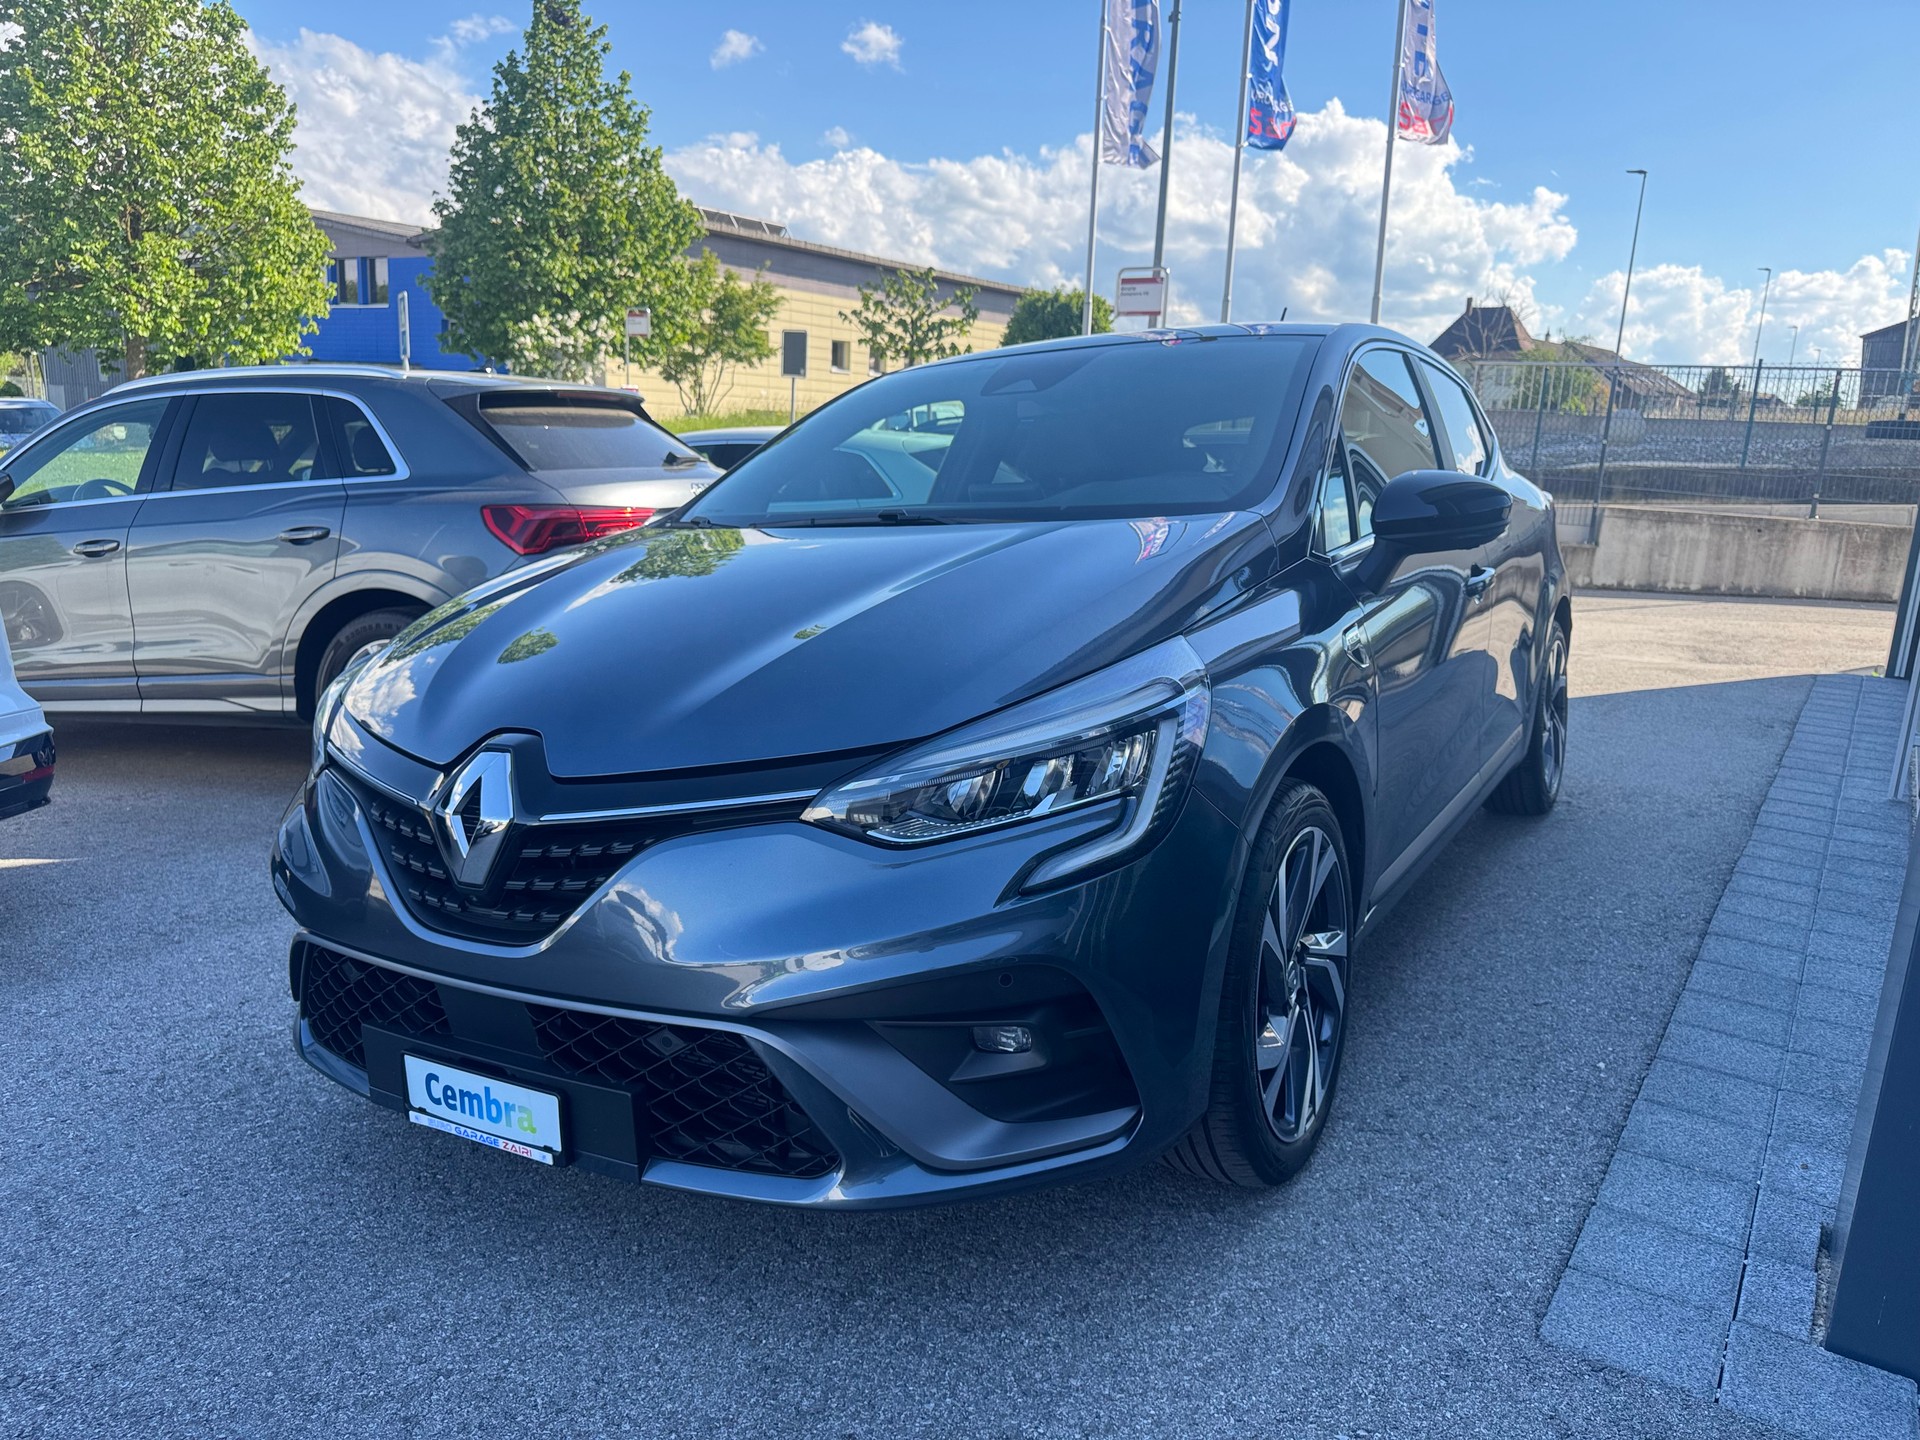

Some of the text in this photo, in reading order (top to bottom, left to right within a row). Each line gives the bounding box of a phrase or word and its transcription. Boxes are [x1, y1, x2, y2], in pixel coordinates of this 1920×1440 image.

[425, 1072, 537, 1134] Cembra
[454, 1126, 499, 1148] GARAGE
[502, 1141, 532, 1158] ZAIRI
